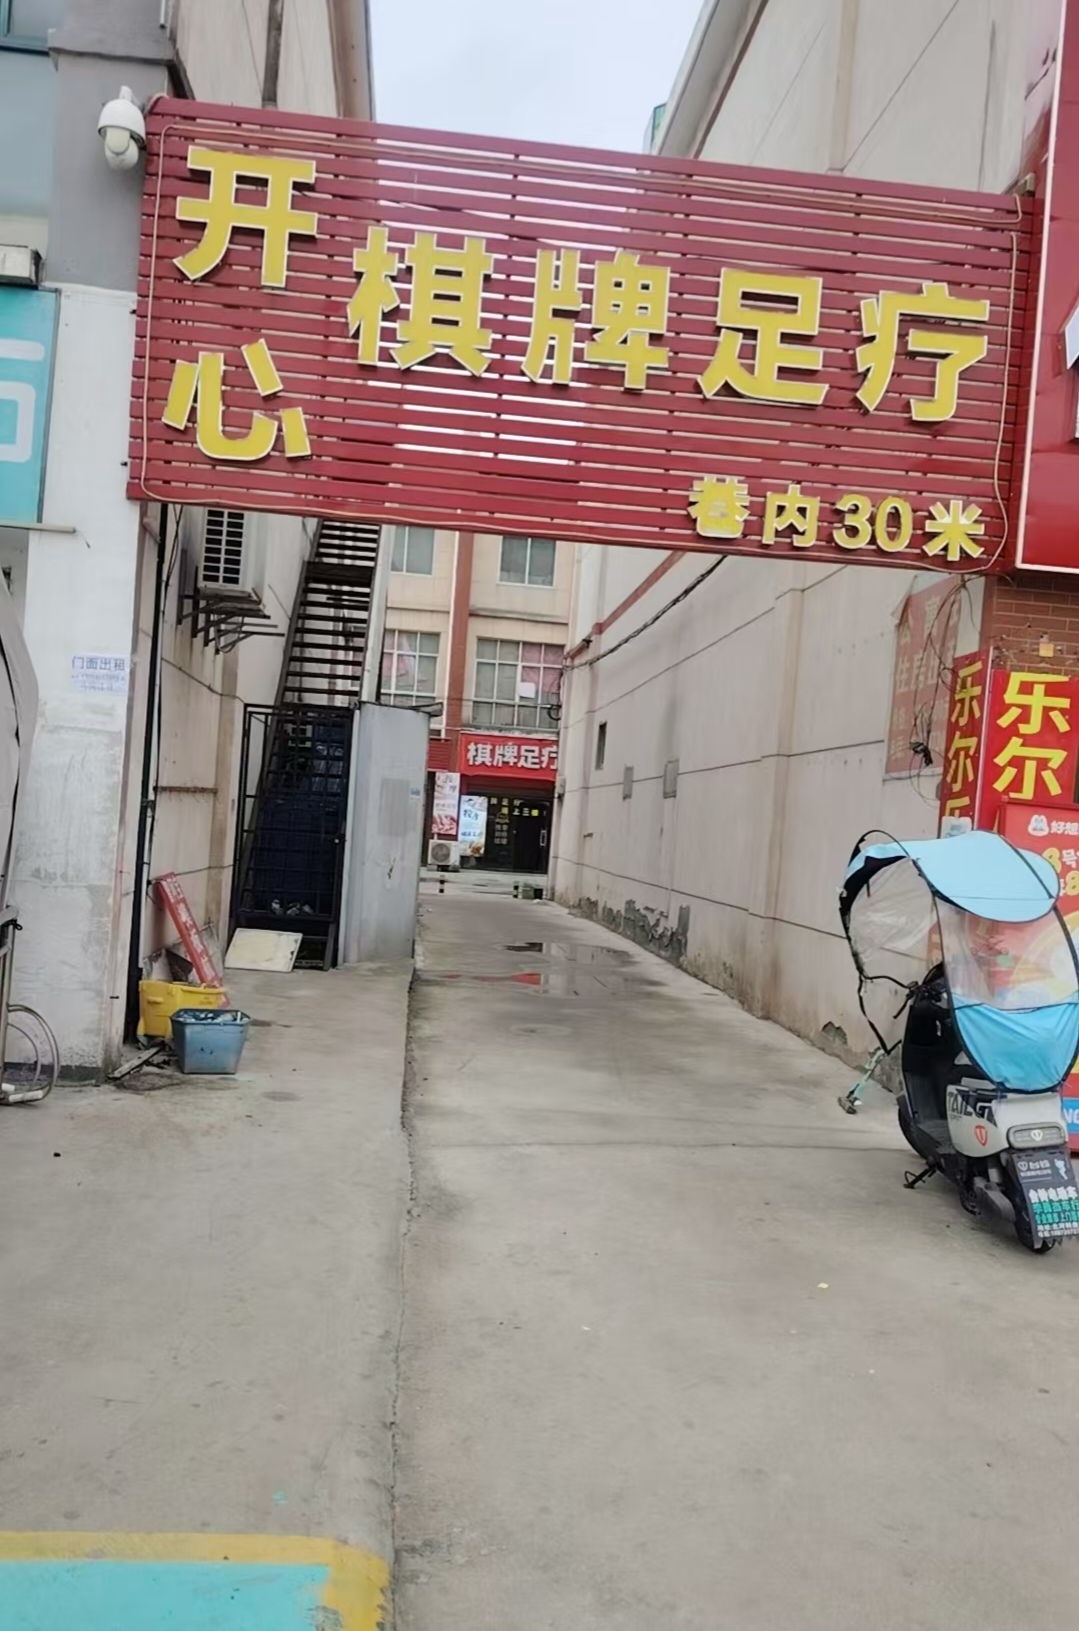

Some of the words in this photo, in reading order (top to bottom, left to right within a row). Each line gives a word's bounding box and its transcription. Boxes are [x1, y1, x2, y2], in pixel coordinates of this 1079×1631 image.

[161, 145, 318, 462] 开心
[346, 225, 990, 422] 棋牌足疗
[993, 671, 1071, 800] 乐尔
